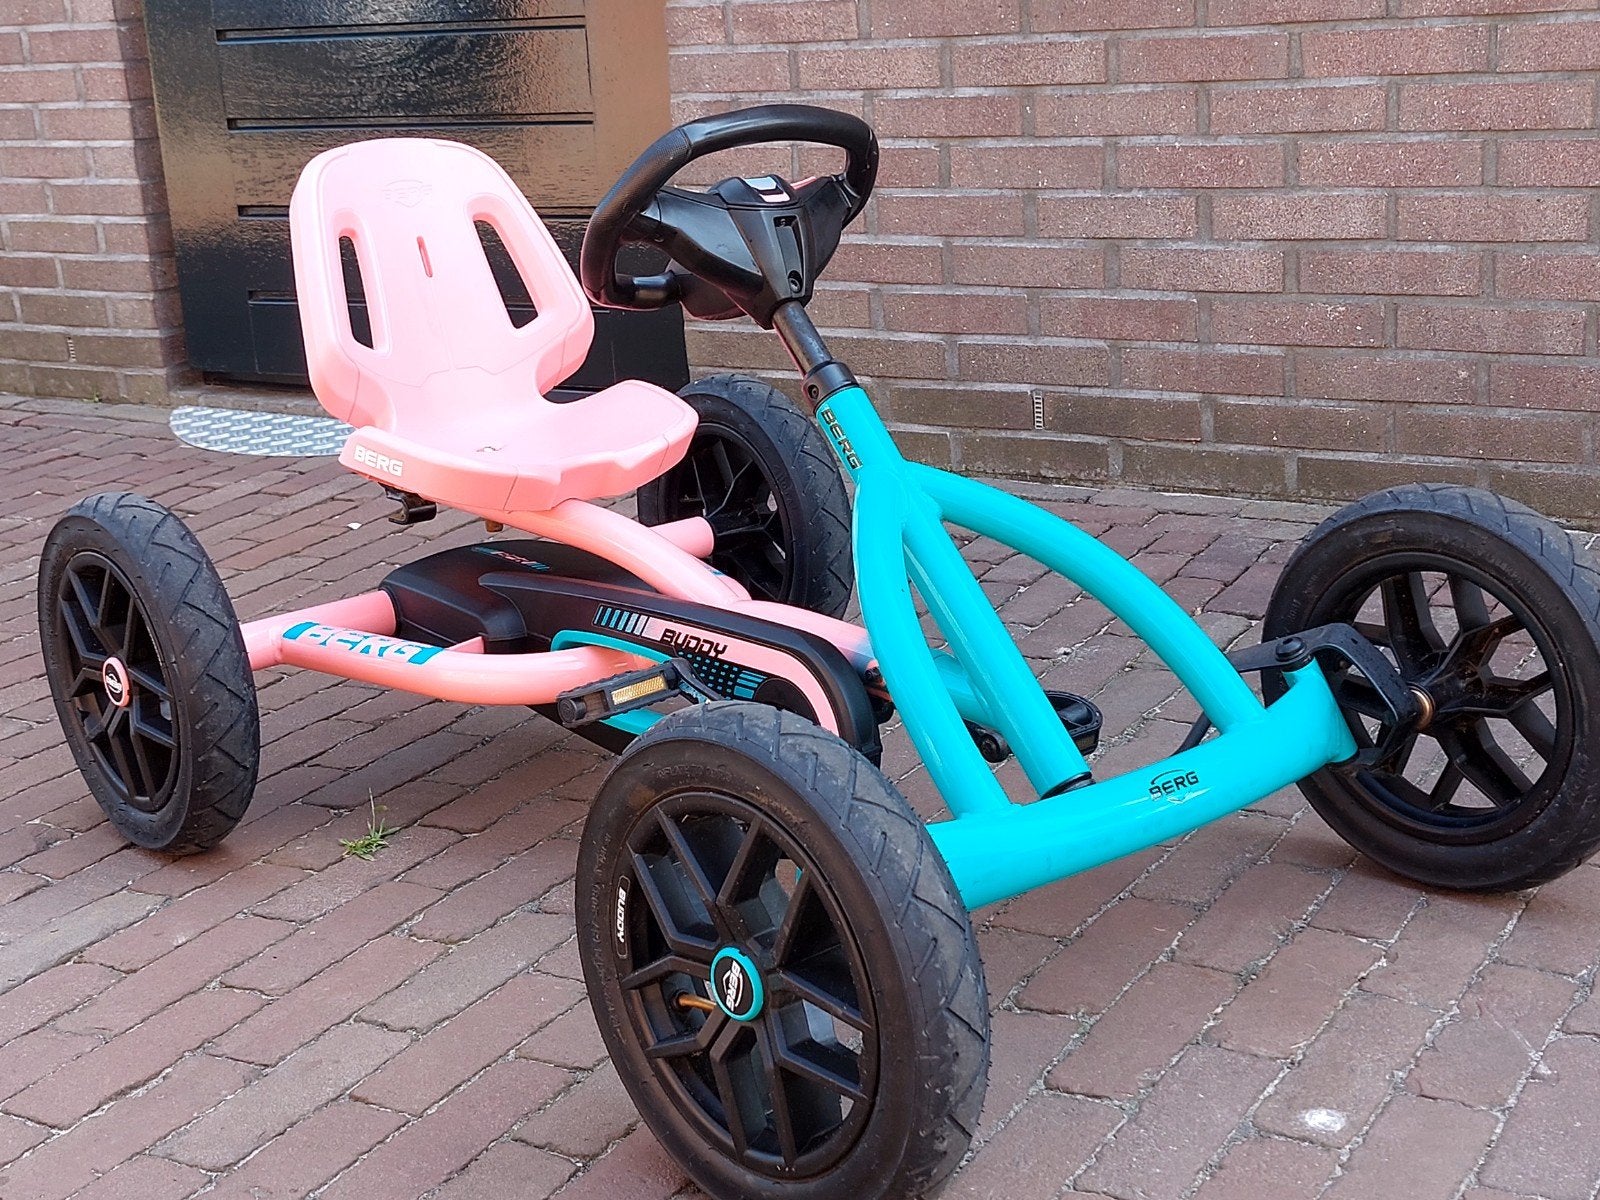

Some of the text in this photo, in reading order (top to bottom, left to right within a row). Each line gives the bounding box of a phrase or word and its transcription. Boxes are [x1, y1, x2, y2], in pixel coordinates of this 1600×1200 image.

[820, 407, 864, 470] BERG
[353, 444, 404, 477] BERG
[295, 622, 425, 664] BERG
[660, 627, 729, 659] BUDDY
[1148, 770, 1200, 801] BERG
[616, 886, 627, 943] BUDDY
[725, 959, 741, 1012] BERG
